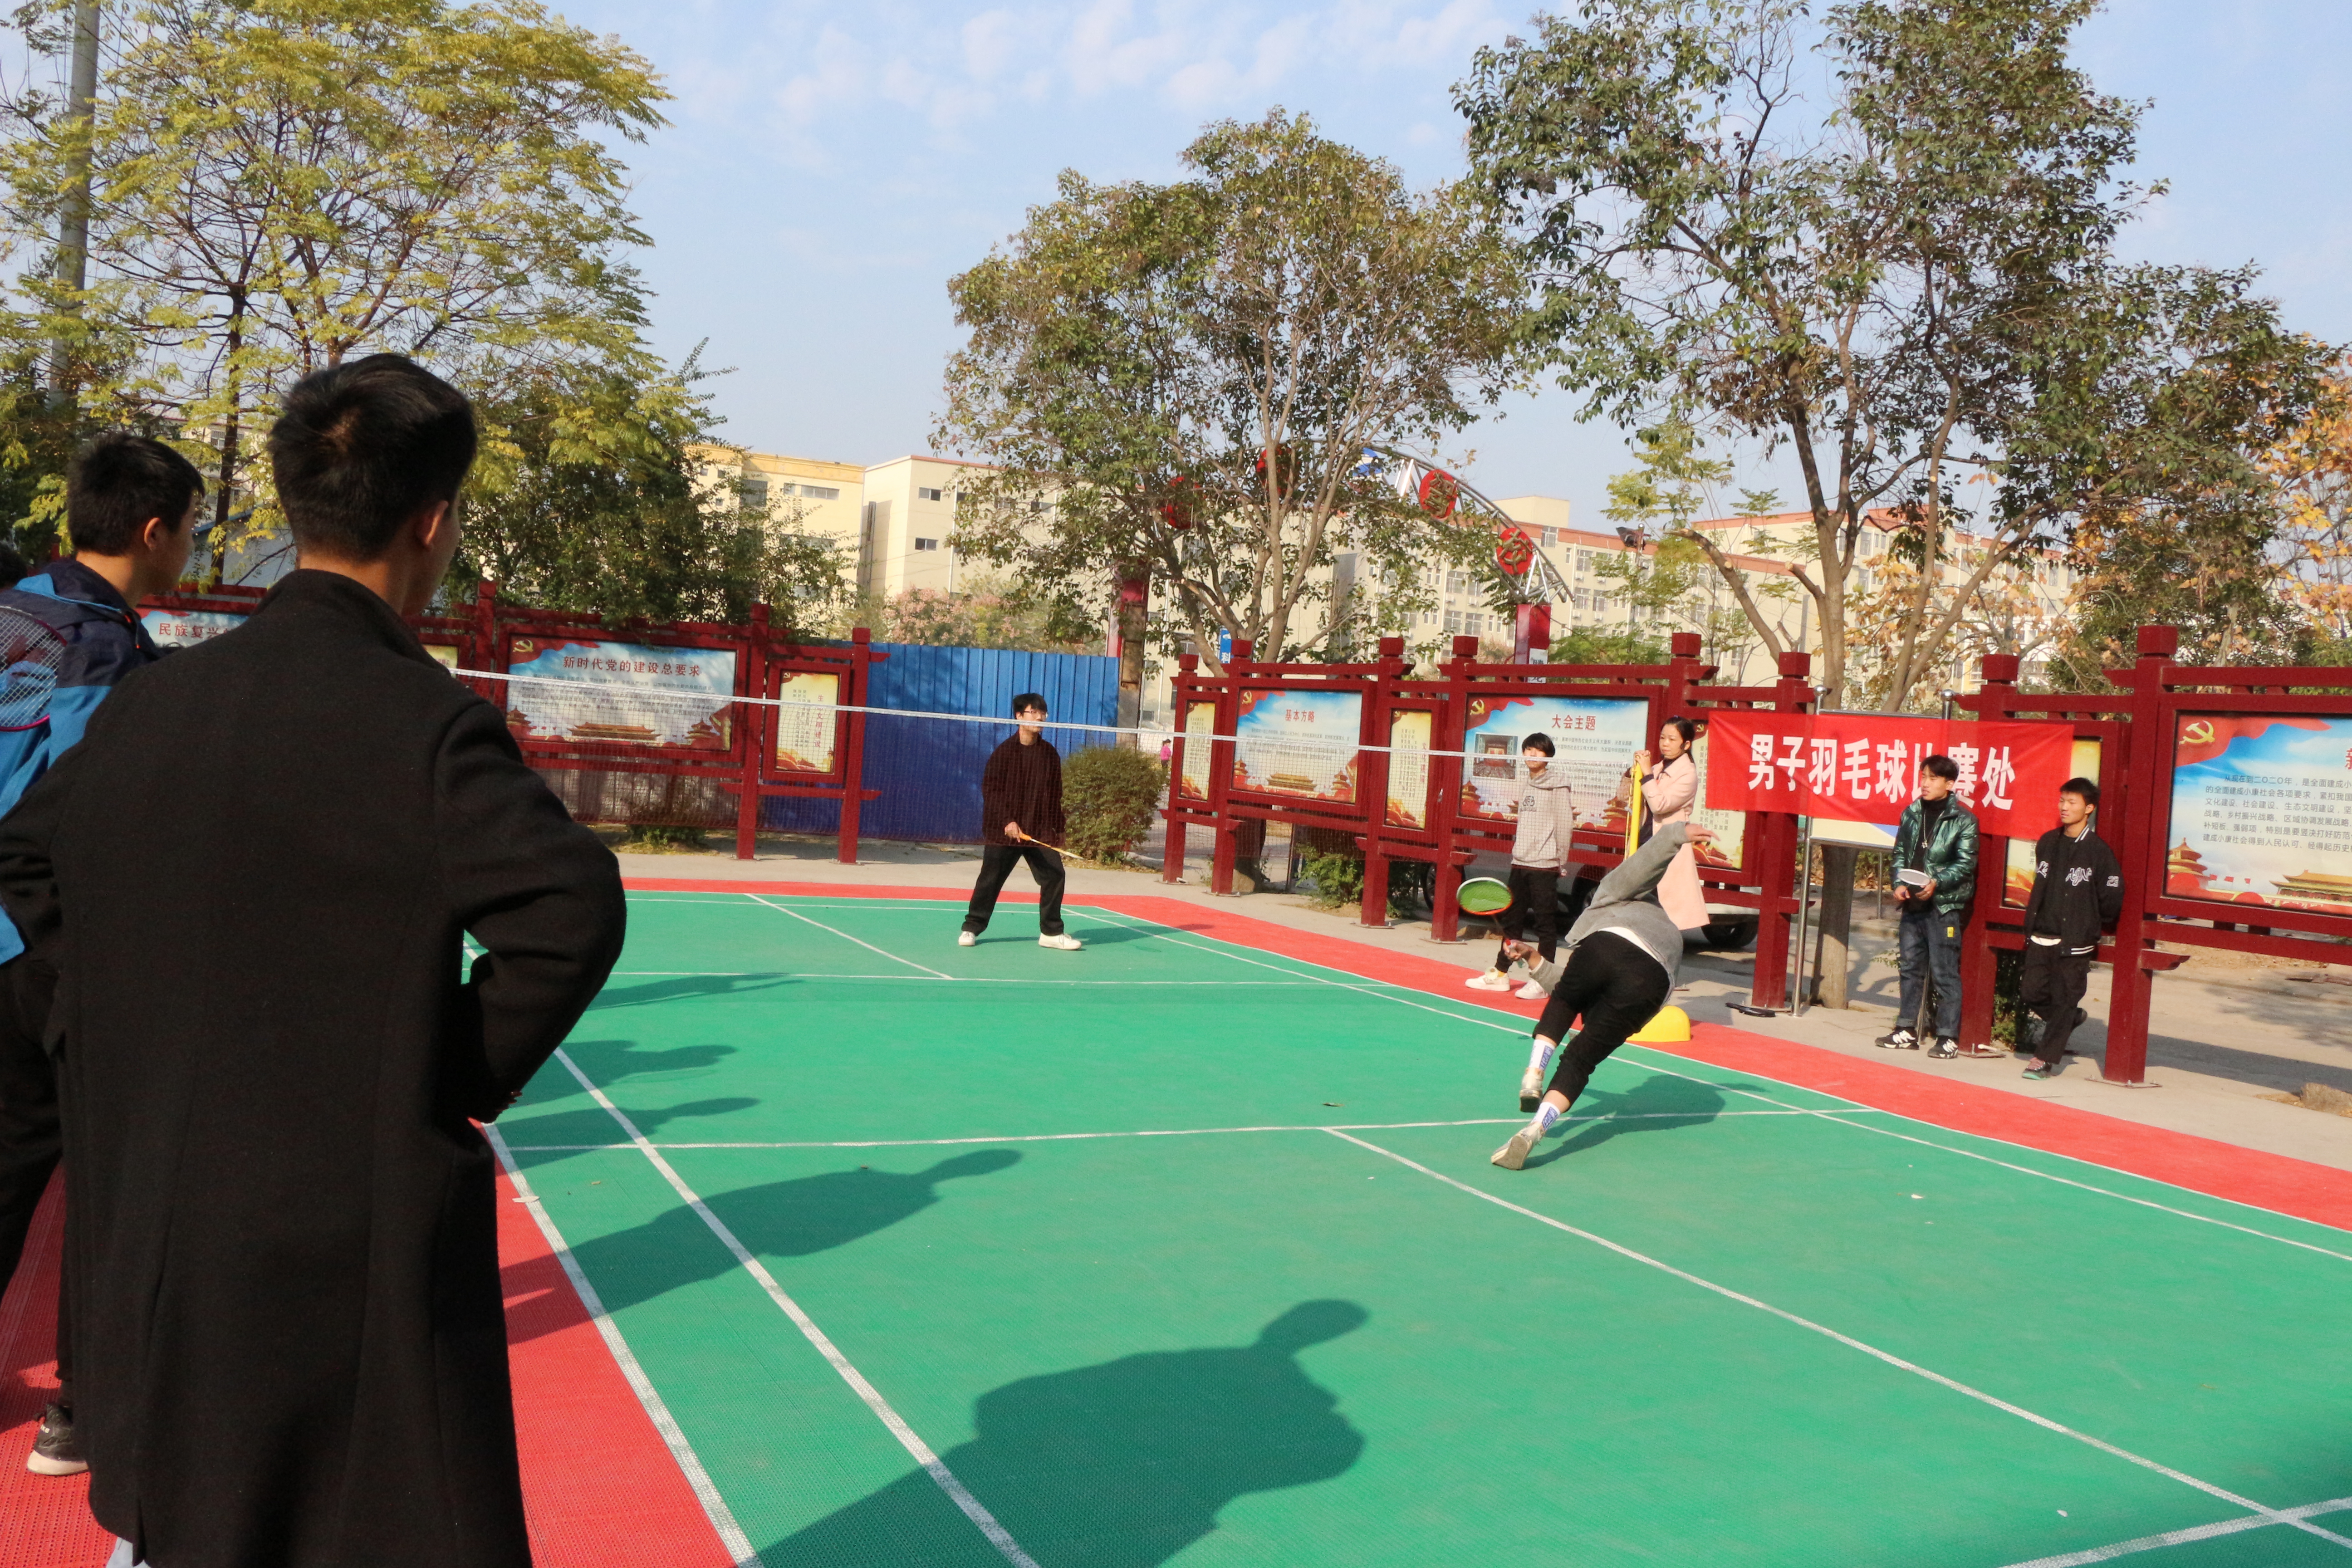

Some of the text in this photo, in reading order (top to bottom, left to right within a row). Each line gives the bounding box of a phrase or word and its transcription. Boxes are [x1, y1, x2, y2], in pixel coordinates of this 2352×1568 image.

[159, 622, 233, 638] 民族复兴
[563, 656, 700, 676] 新时代党的建设总要求
[1284, 709, 1315, 723] 基本方略
[1551, 714, 1597, 730] 大会主题
[2203, 833, 2352, 853] 建成小康社会得到人民认可、经得起历史
[2106, 875, 2119, 887] 23
